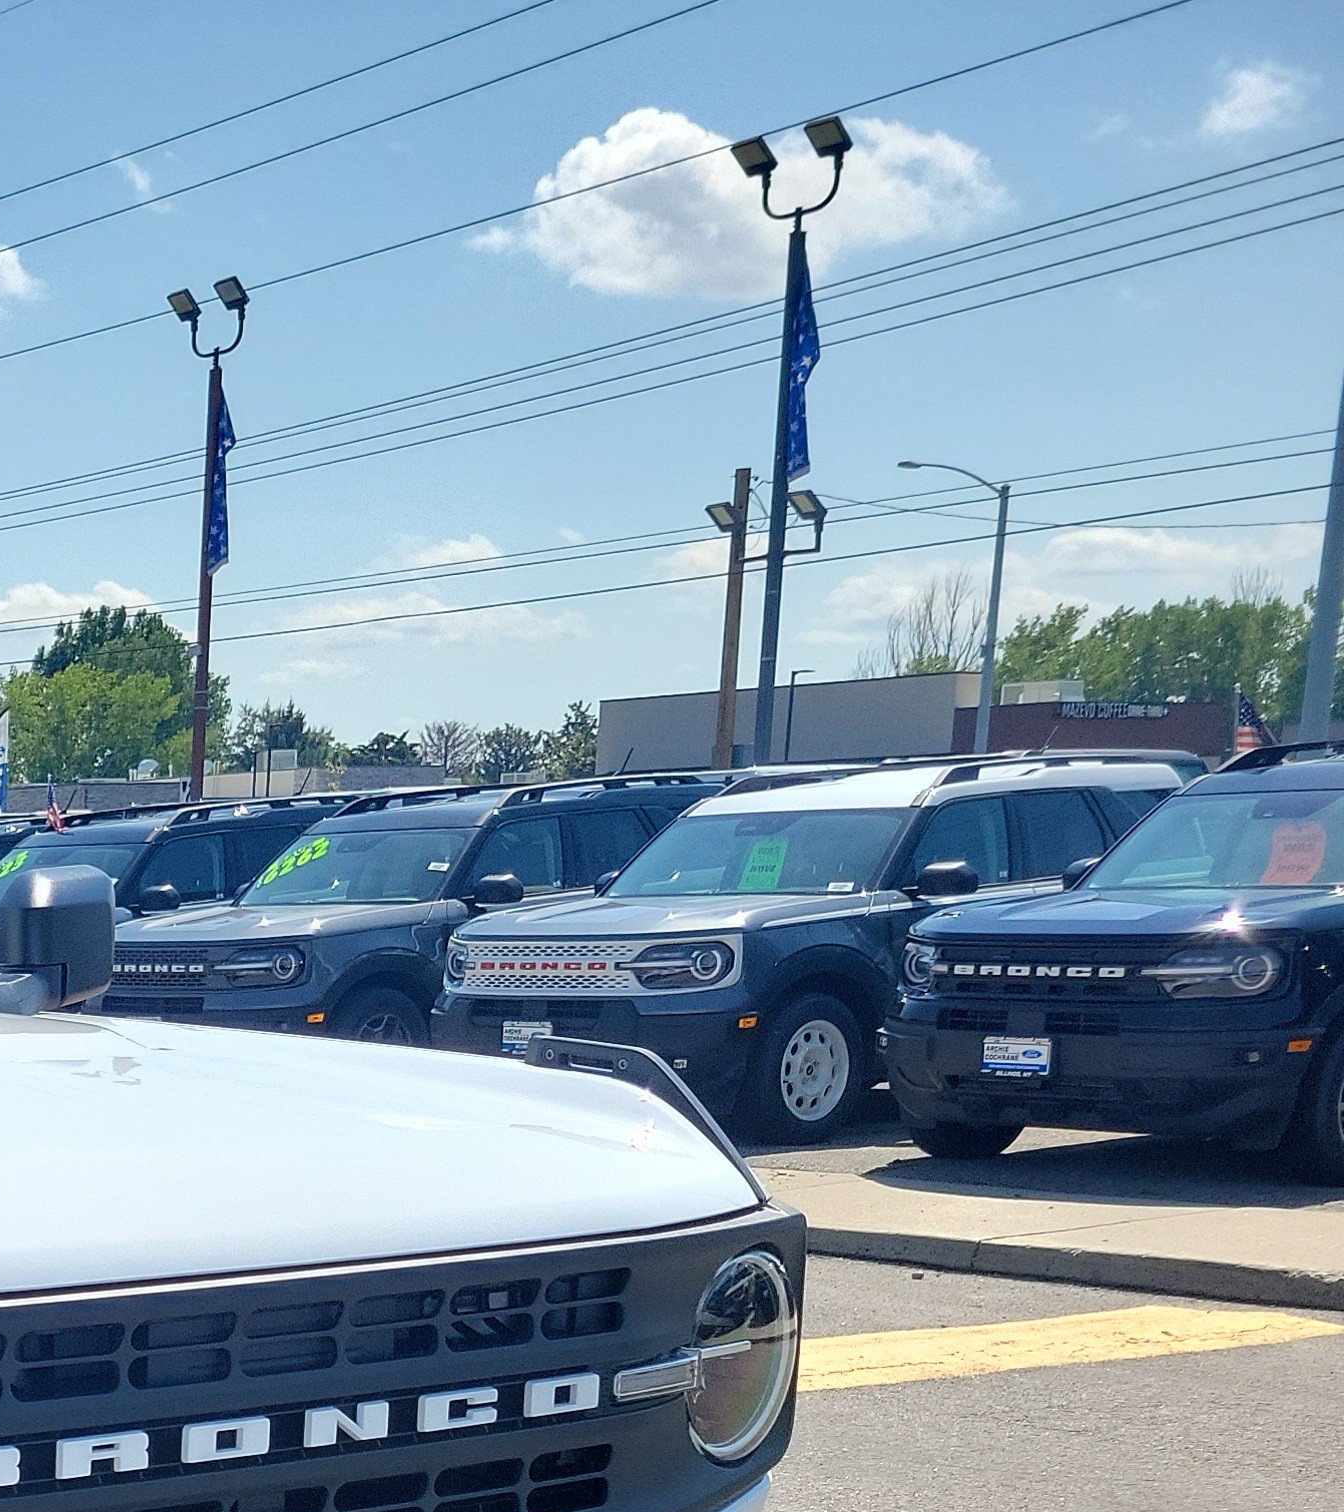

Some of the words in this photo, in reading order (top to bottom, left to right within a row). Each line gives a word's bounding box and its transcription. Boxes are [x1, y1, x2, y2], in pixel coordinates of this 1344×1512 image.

[1097, 702, 1128, 718] COFFEE
[112, 965, 204, 973] BRONCO
[480, 962, 607, 970] BRONCO
[953, 964, 1126, 977] BRONCO
